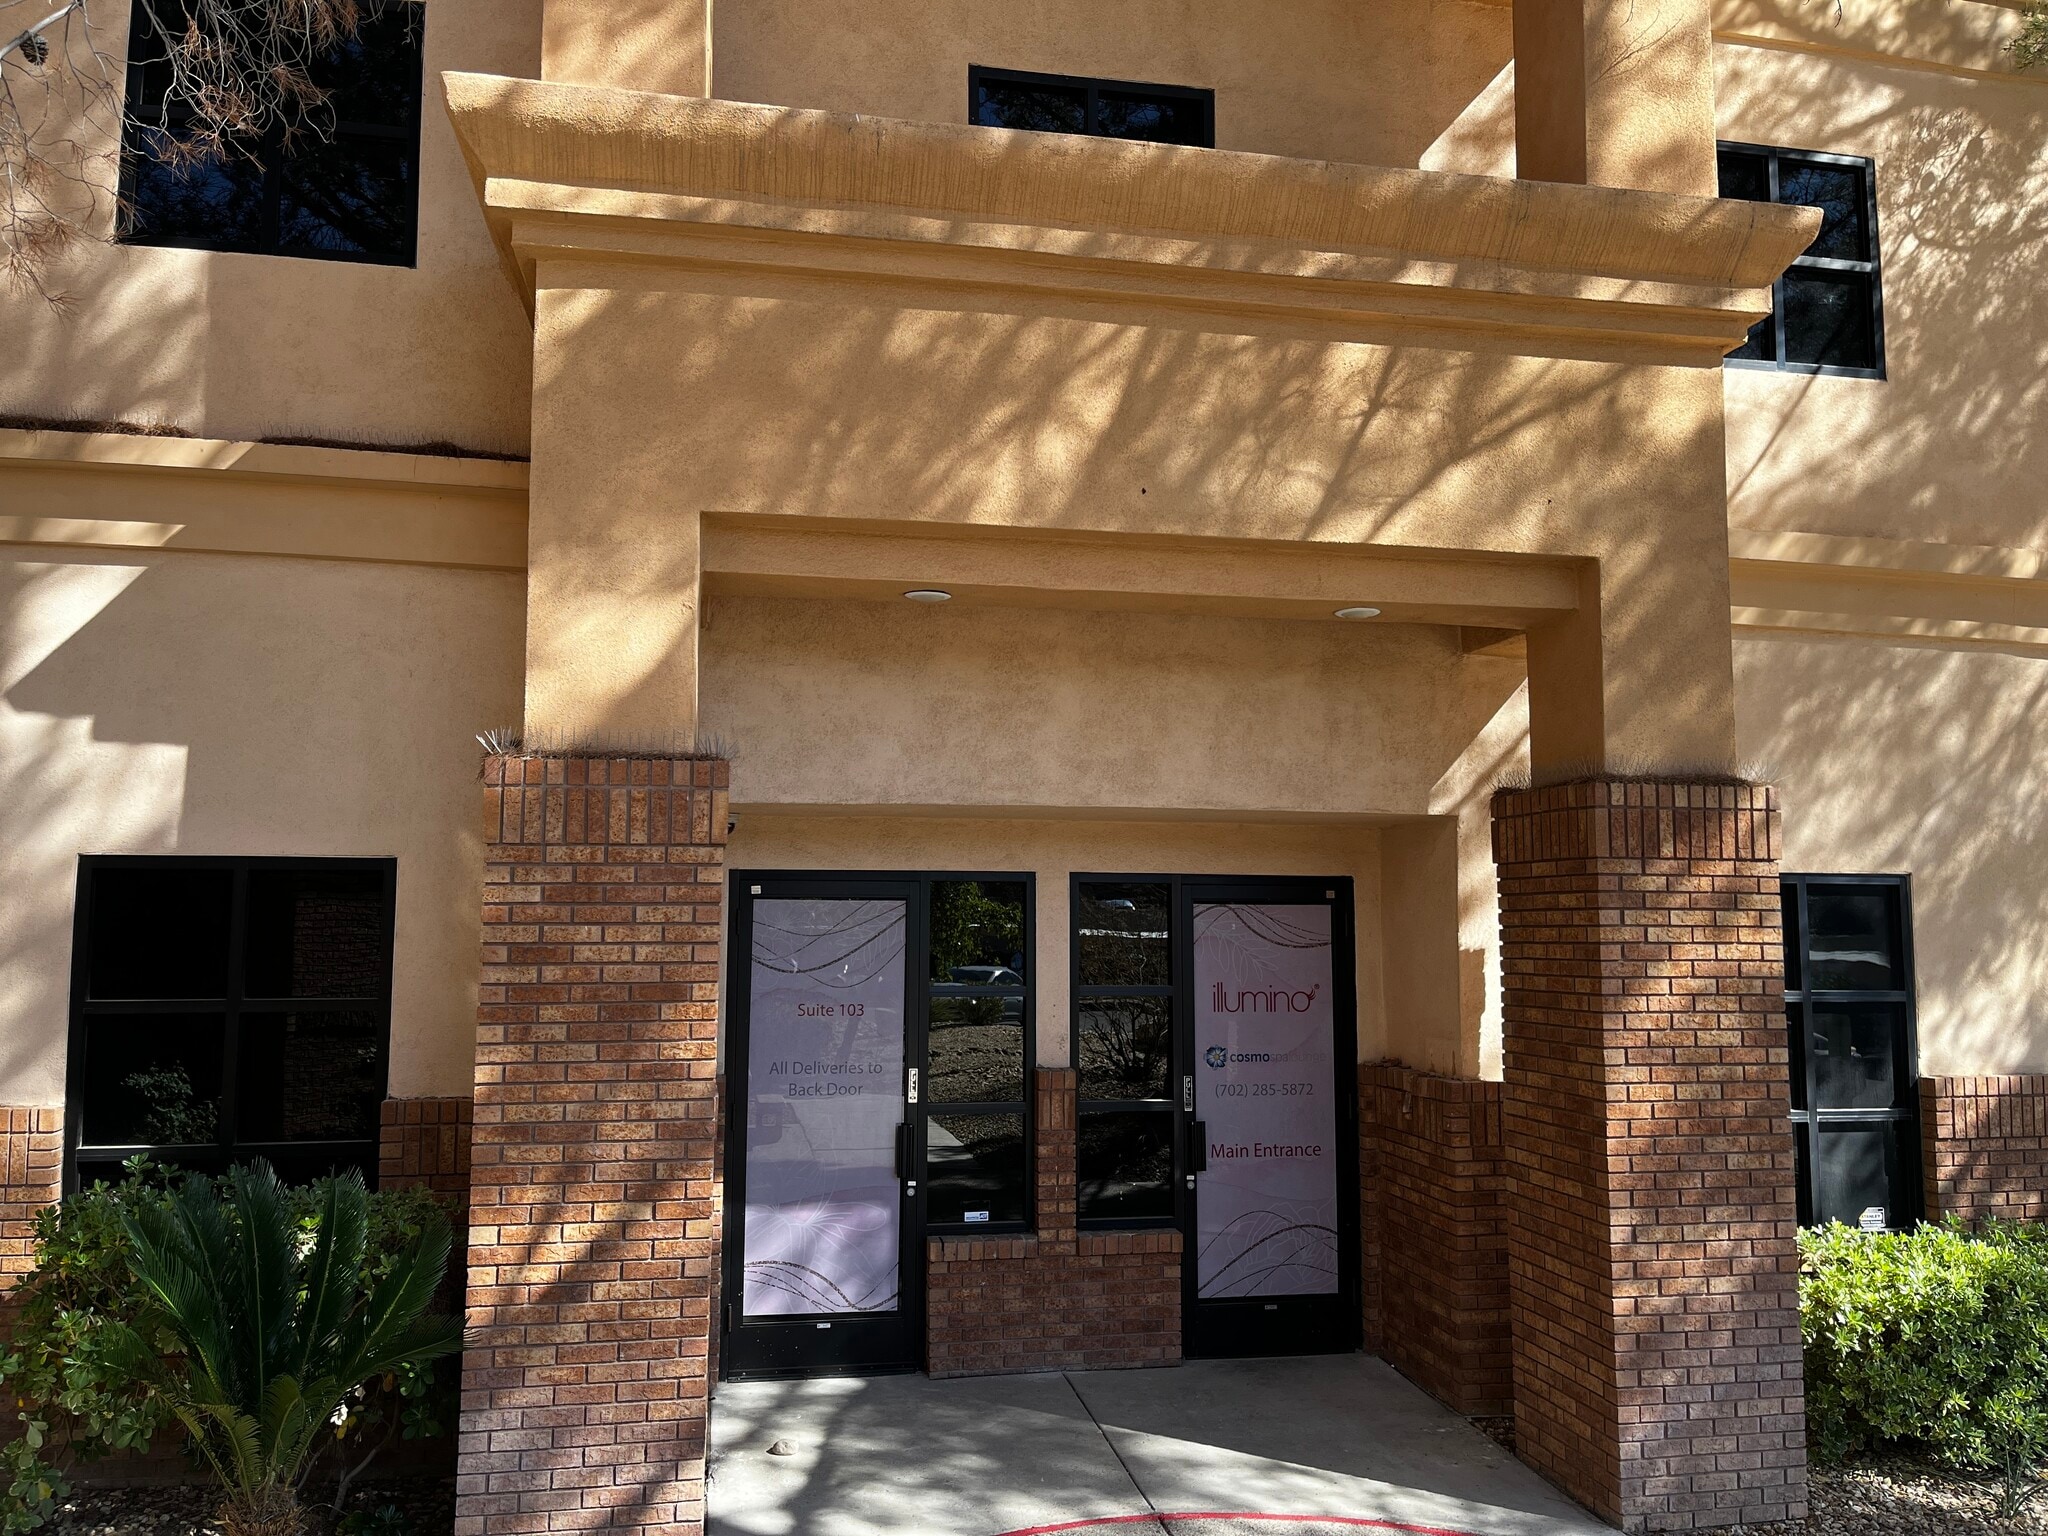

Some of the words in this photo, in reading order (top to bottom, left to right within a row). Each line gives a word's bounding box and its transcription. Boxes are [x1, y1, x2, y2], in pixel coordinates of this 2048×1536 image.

[797, 1003, 835, 1017] Suite
[839, 1003, 865, 1017] 103
[769, 1060, 788, 1075] All
[792, 1060, 864, 1075] Deliveries
[868, 1061, 883, 1075] to
[788, 1082, 823, 1097] Back
[826, 1082, 864, 1096] Door
[1215, 1083, 1248, 1098] (702)
[1252, 1083, 1314, 1097] 285-5872
[1210, 1143, 1249, 1159] Main
[1253, 1142, 1322, 1158] Entrance
